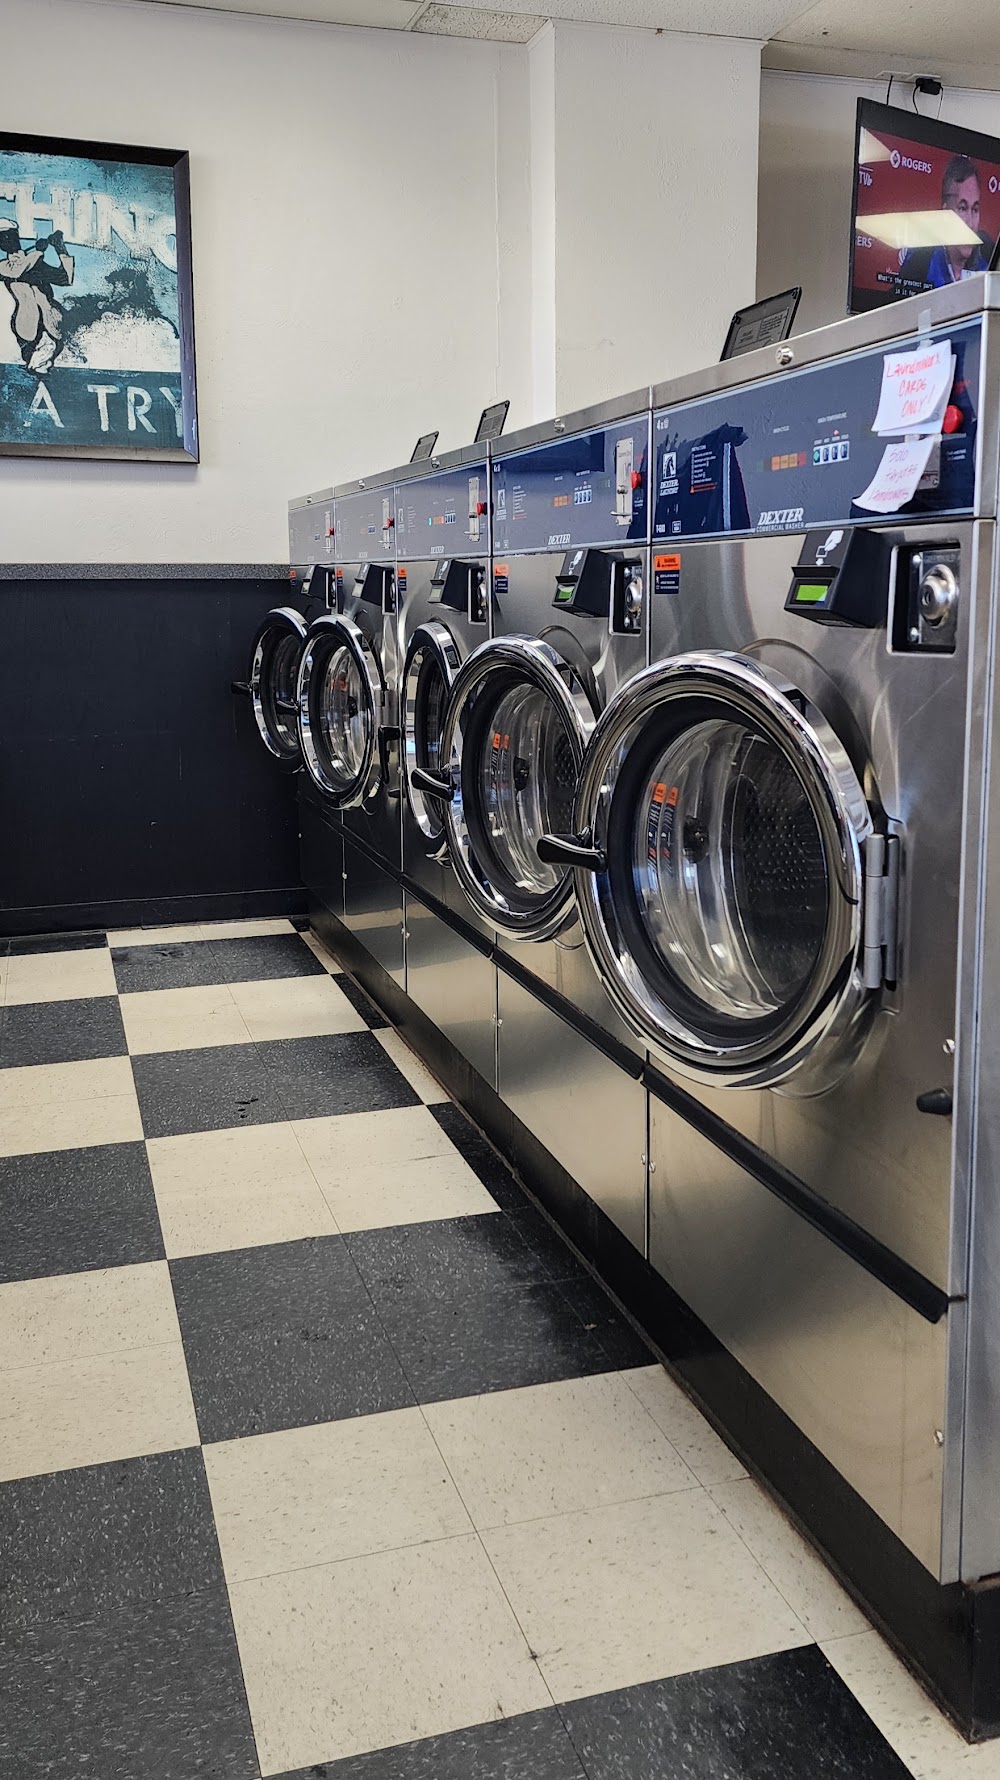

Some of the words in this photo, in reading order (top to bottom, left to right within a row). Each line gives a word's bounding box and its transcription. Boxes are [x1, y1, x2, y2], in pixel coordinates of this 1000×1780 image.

[901, 156, 932, 174] ROGERS
[857, 236, 873, 248] ERS
[23, 381, 66, 429] A
[87, 384, 184, 438] TRY
[757, 507, 804, 526] DEXTER
[756, 524, 785, 533] COMMERCIAL
[785, 522, 805, 530] WASHER
